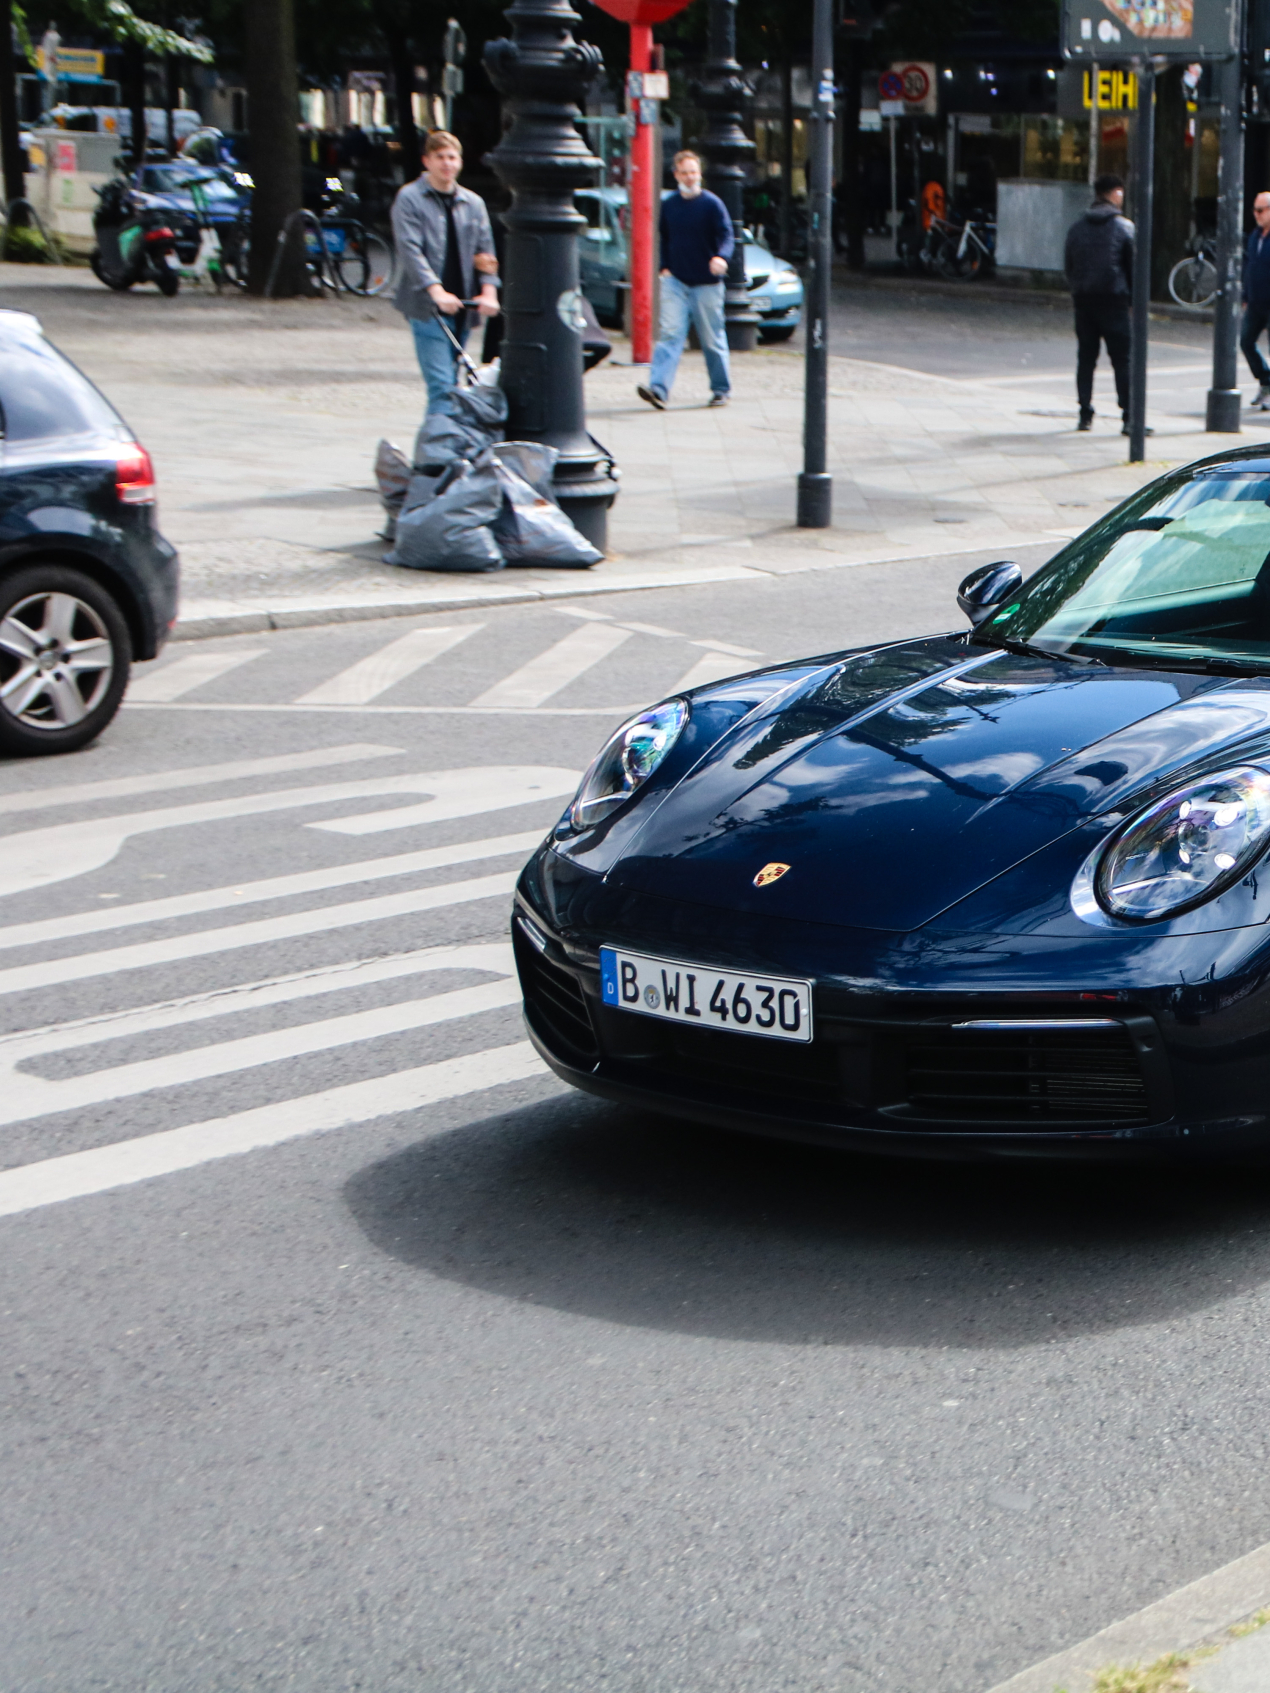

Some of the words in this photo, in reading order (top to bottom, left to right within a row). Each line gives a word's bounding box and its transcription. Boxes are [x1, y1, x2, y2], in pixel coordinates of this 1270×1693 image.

[1083, 70, 1138, 110] LEIH
[607, 982, 614, 994] D
[620, 960, 640, 1004] B
[661, 968, 702, 1017] WI
[709, 979, 802, 1032] 4630
